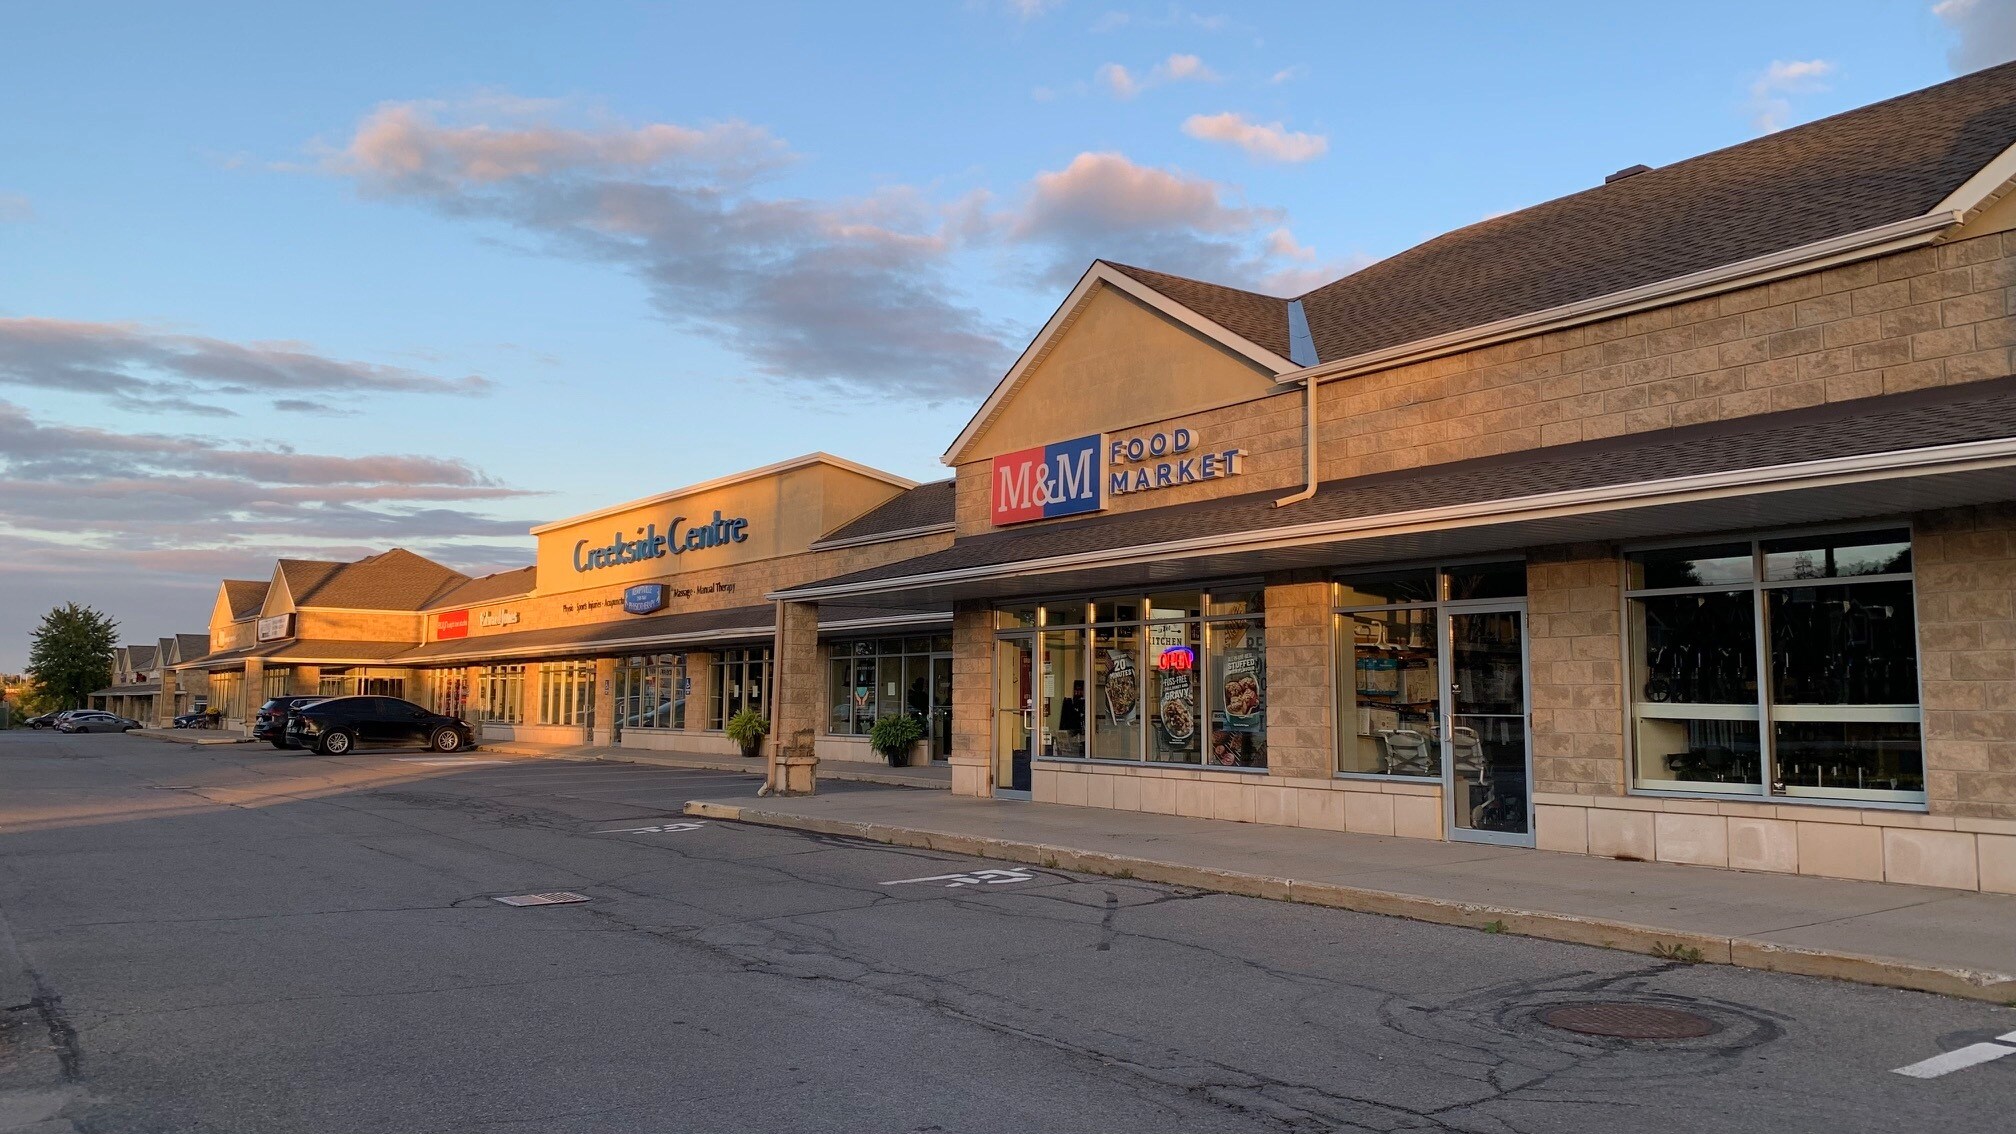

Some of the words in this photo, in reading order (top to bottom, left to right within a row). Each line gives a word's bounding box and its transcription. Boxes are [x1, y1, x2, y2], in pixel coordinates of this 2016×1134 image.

[1109, 428, 1198, 465] FOOD
[1109, 449, 1247, 494] MARKET
[998, 448, 1094, 512] M&M
[573, 523, 667, 573] Creekside
[667, 510, 749, 555] Centre
[673, 588, 694, 600] Massage
[697, 583, 715, 595] Manual
[716, 582, 736, 594] Therapy
[1150, 637, 1182, 646] ITCHEN
[1113, 659, 1126, 672] 20
[1159, 651, 1192, 669] OPEN
[1227, 659, 1255, 670] STUFFED
[1109, 669, 1132, 679] MINUTES
[1164, 675, 1188, 686] FUSS-FREE
[1164, 688, 1190, 700] GRAVY
